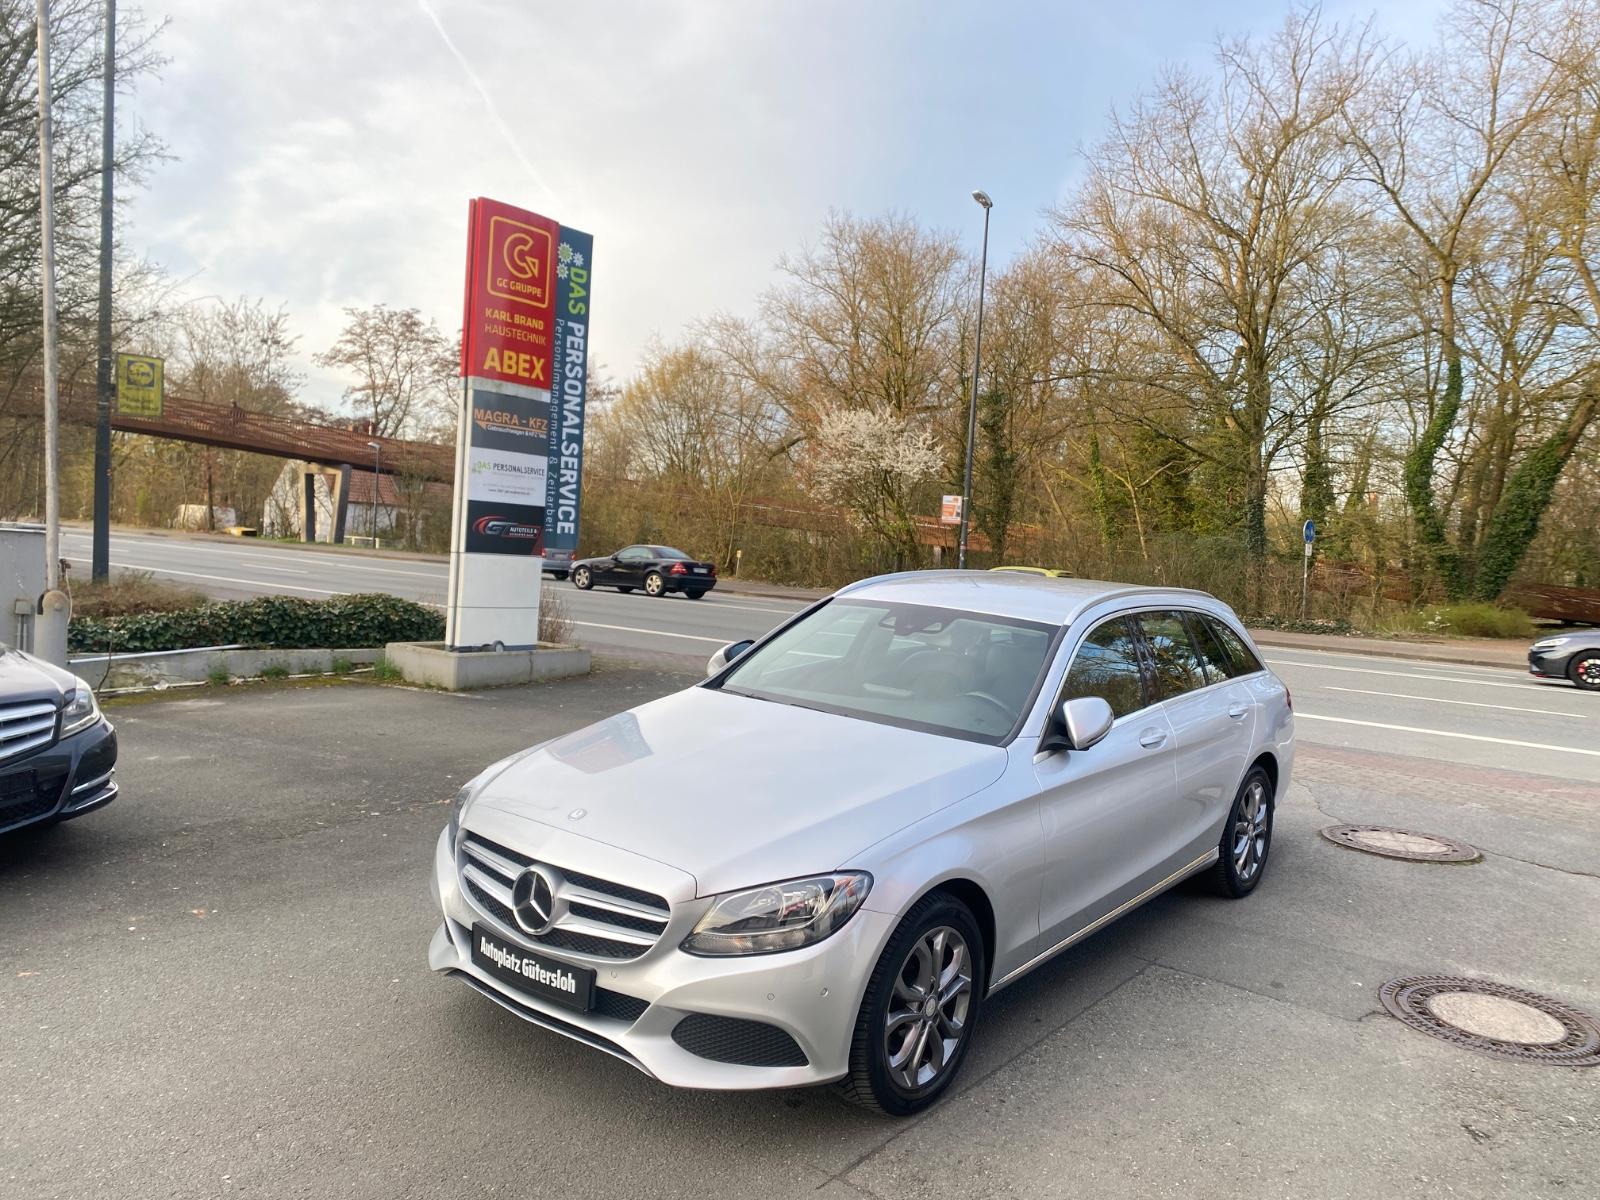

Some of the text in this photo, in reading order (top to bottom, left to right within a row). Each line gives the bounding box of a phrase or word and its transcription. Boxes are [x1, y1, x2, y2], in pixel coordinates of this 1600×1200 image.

[496, 277, 542, 298] GC GRUPPE
[485, 307, 544, 331] KARL BRAND
[484, 323, 547, 346] HAUSTECHNIK
[483, 346, 545, 381] ABEX
[556, 266, 588, 534] DAS PERSONALSERVICE
[474, 408, 519, 426] MAGRA
[529, 416, 548, 431] KFZ
[545, 318, 565, 533] Personalmanagement & Zeitarbeit
[493, 463, 545, 476] PERSONALSERVICE
[480, 936, 576, 994] Autoplatz Gütersloh
